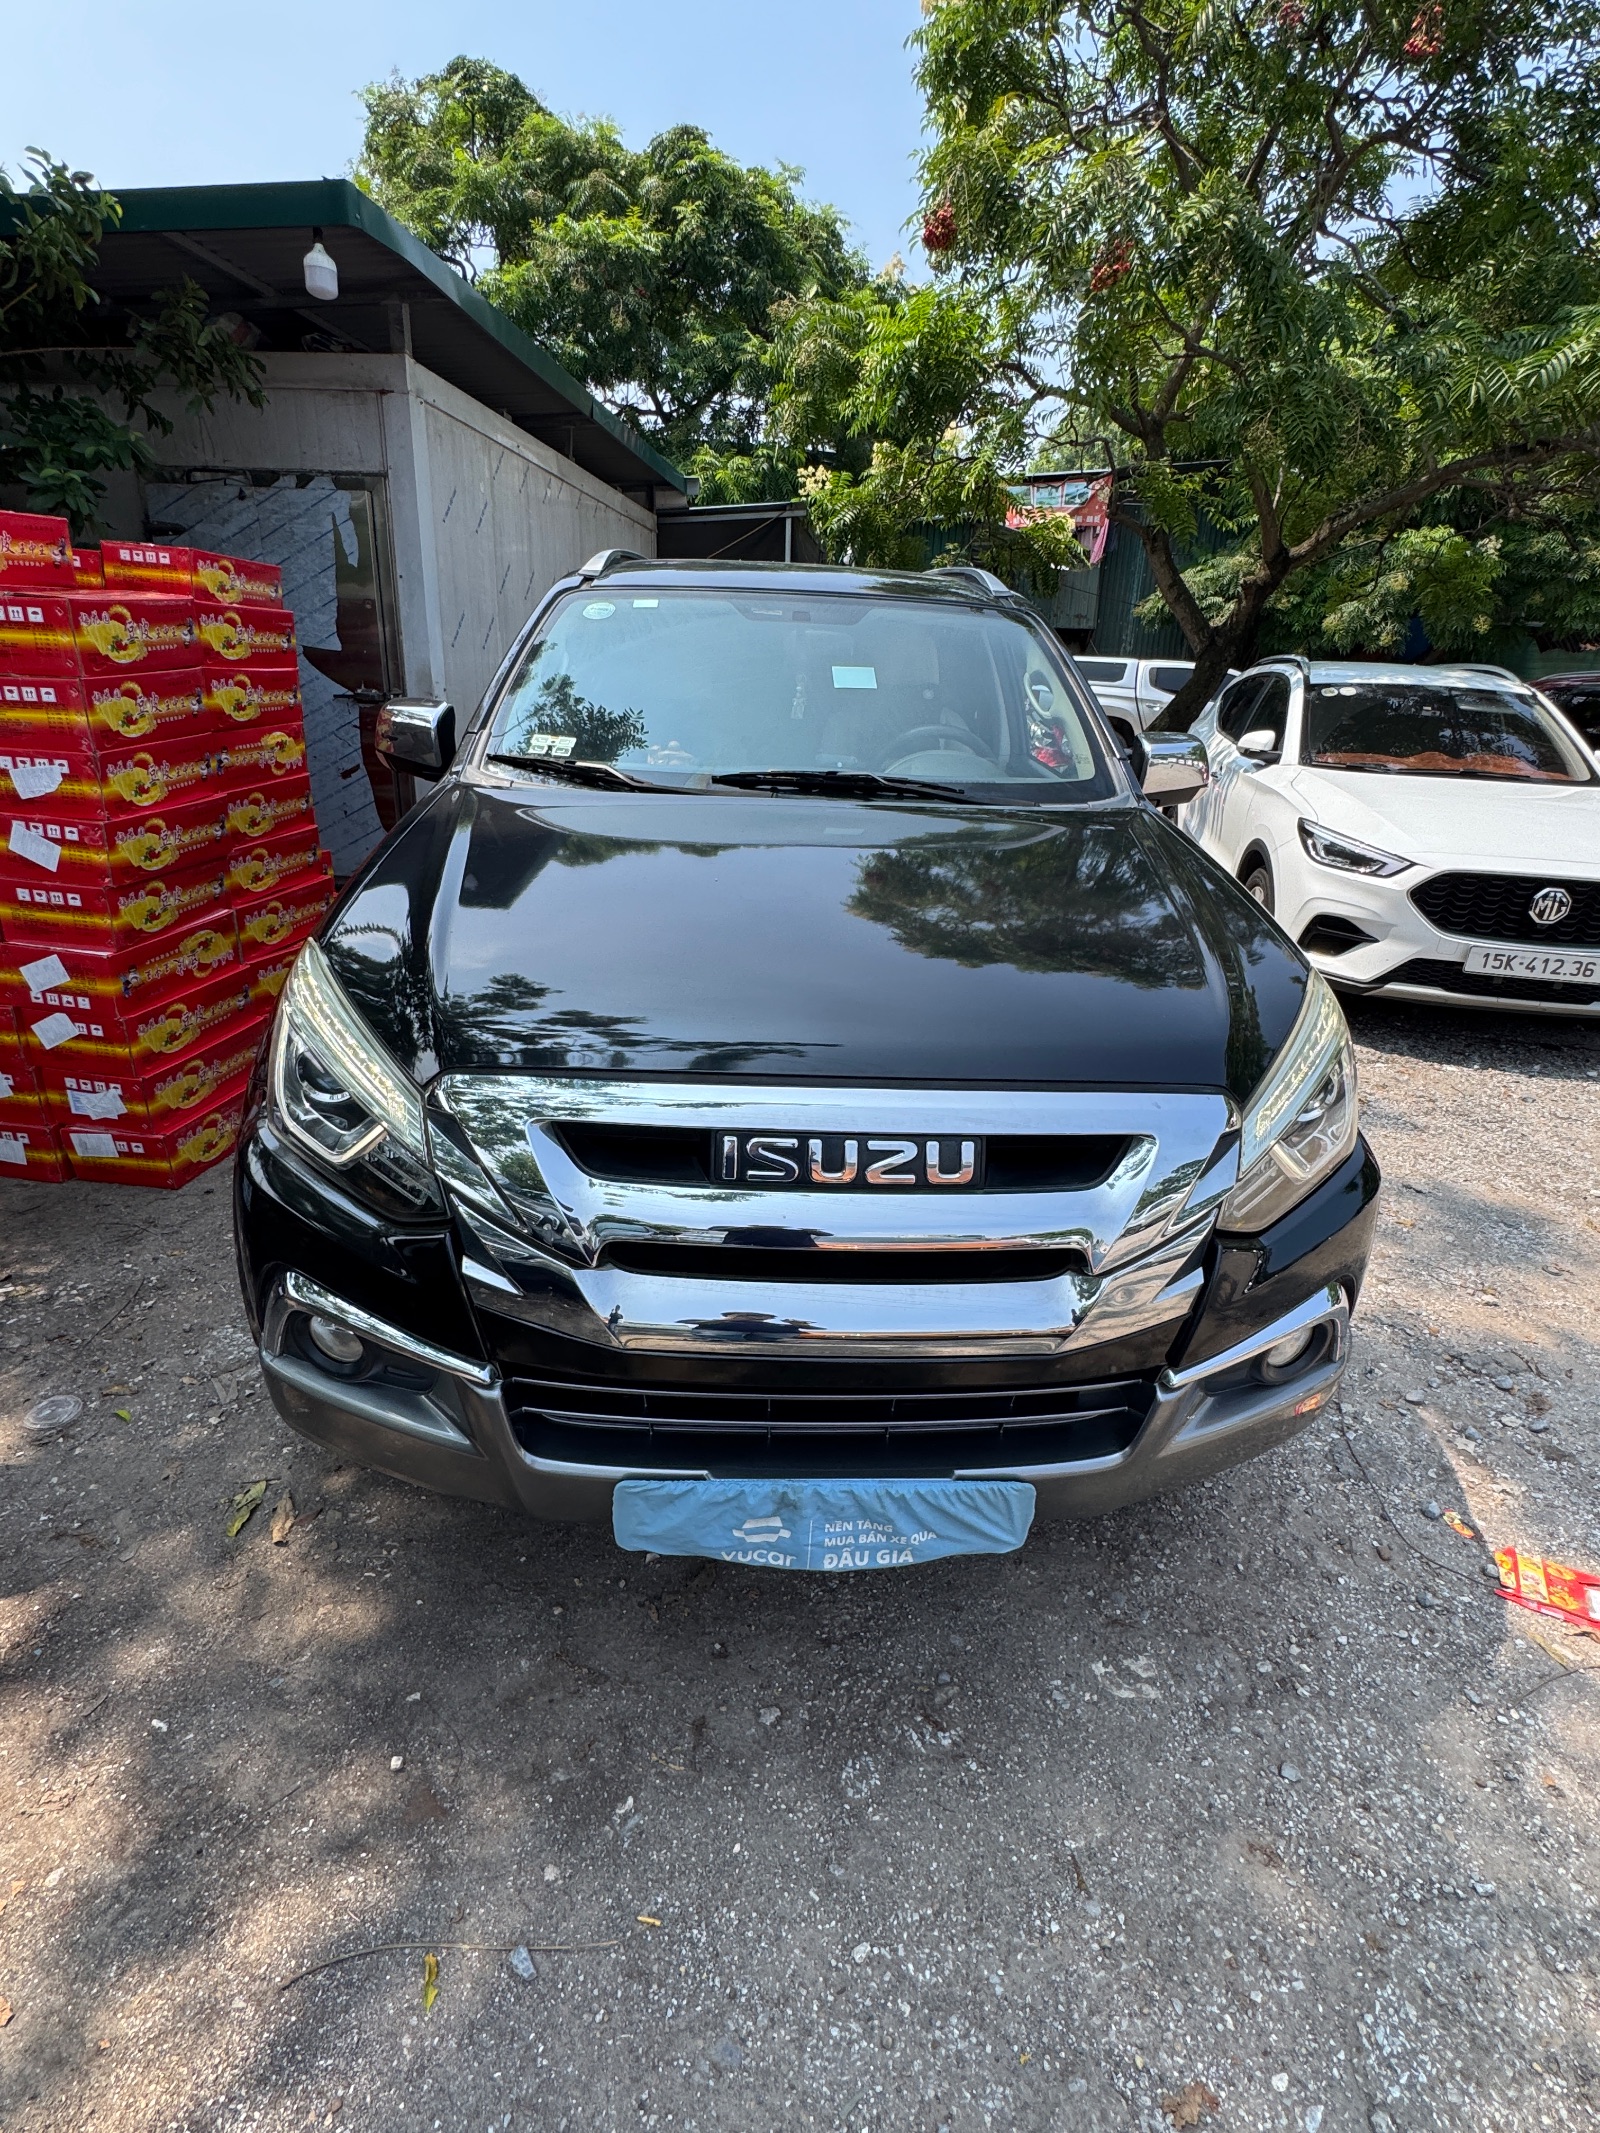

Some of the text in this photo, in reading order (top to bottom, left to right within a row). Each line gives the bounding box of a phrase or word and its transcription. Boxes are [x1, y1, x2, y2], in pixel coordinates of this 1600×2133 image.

[1534, 891, 1568, 921] MG
[1482, 952, 1597, 978] 15K-412.36
[723, 1136, 975, 1184] ISUZU
[824, 1531, 938, 1547] MUA BÁN XE QUA
[721, 1549, 797, 1567] vucar
[823, 1546, 914, 1569] ĐẤU GIÁ
